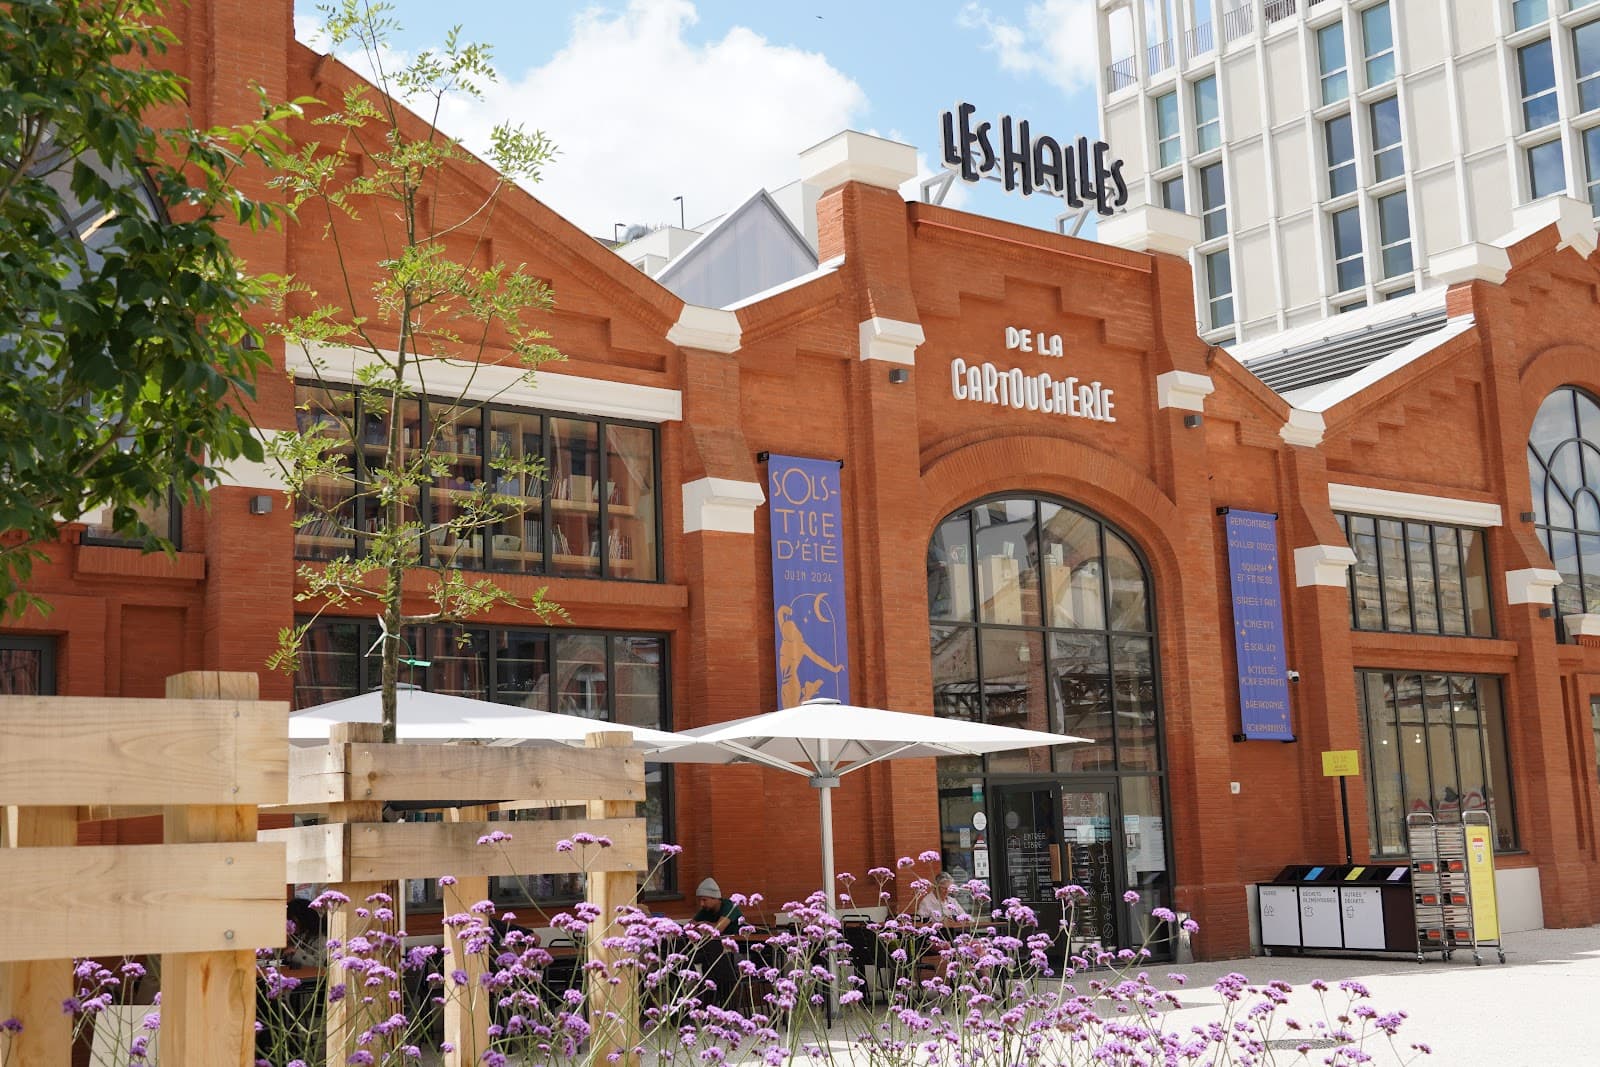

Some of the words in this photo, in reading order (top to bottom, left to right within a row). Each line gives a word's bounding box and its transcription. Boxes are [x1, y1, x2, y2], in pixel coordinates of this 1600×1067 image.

[942, 102, 995, 182] LES
[1002, 115, 1130, 217] HALLES
[1005, 326, 1033, 352] DE
[1037, 332, 1064, 357] LA
[951, 357, 1116, 422] CARTOUCHERIE
[772, 467, 838, 505] SOLS-
[774, 507, 837, 539] TICE
[784, 569, 806, 582] JUIN
[811, 571, 833, 584] 2024
